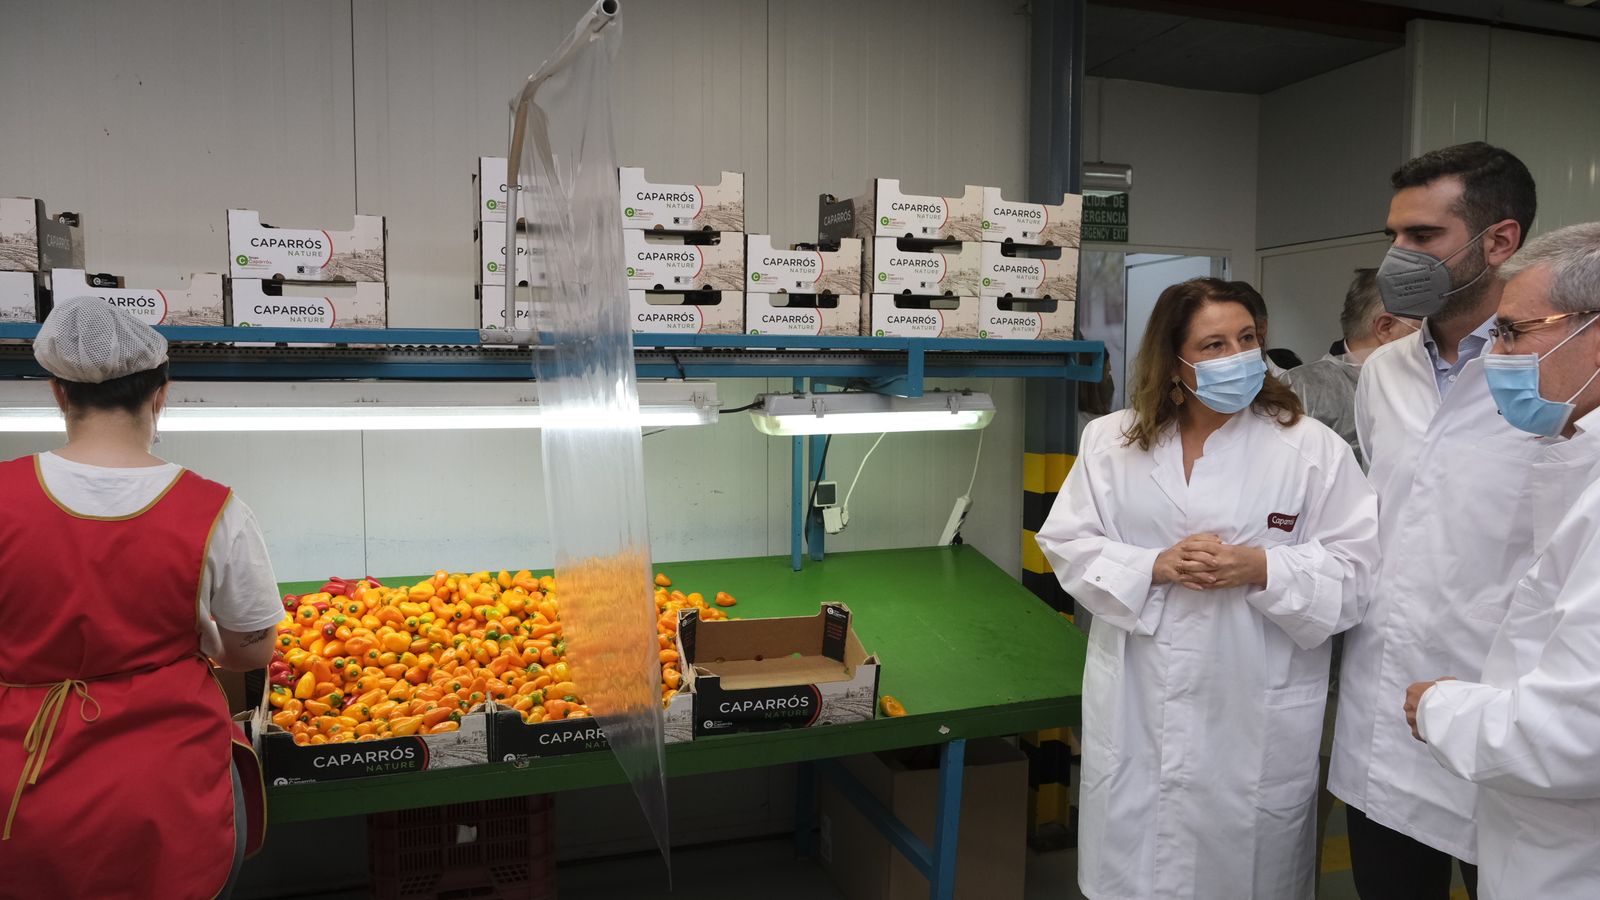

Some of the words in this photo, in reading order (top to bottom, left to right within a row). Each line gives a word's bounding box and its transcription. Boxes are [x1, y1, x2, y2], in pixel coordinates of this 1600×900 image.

[636, 191, 695, 202] CAPARRÓS
[1084, 196, 1106, 208] LIDA
[891, 202, 942, 214] CAPARRÓS
[993, 207, 1042, 219] CAPARRÓS
[823, 208, 852, 226] CAPARRÓS
[1083, 210, 1127, 225] ERGENCIA
[1082, 227, 1110, 240] ERGENCY
[250, 237, 322, 250] CAPARRÓS
[637, 251, 695, 262] CAPARRÓS
[762, 256, 816, 267] CAPARRÓS
[889, 258, 940, 268] CAPARRÓS
[992, 264, 1039, 274] CAPARRÓS
[253, 304, 325, 316] CAPARRÓS
[637, 312, 695, 322] CAPARRÓS
[761, 314, 815, 324] CAPARRÓS
[887, 315, 937, 325] CAPARRÓS
[990, 317, 1036, 326] CAPARRÓS
[719, 694, 809, 714] CAPARRÓS
[764, 709, 809, 719] NATURE
[539, 728, 608, 745] CAPARR
[313, 745, 415, 769] CAPARRÓS
[366, 760, 416, 773] NATURE
